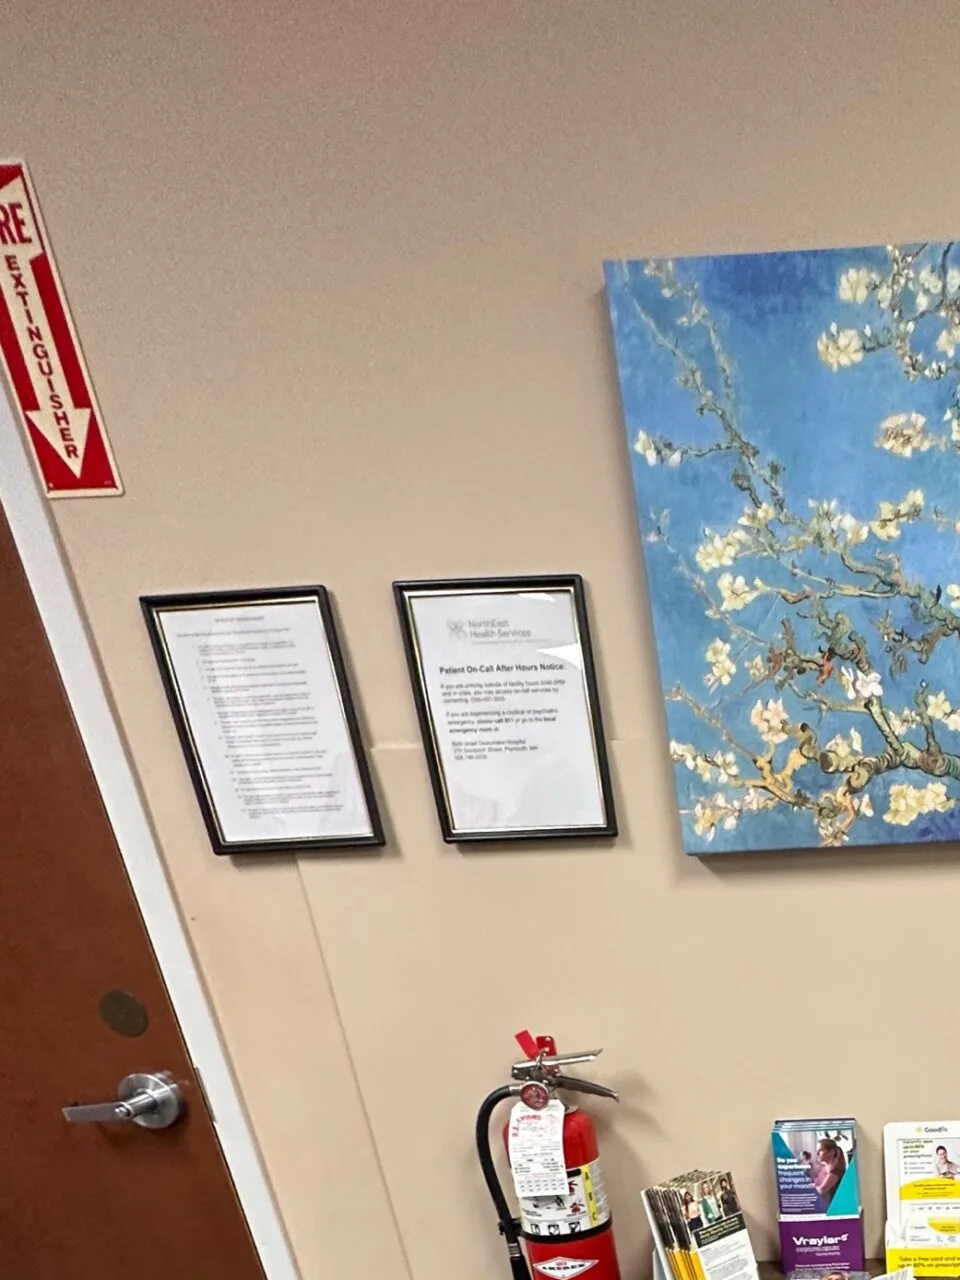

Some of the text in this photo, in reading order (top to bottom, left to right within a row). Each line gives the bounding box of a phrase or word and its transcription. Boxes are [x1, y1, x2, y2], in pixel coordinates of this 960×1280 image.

[0, 202, 33, 245] RE
[4, 254, 80, 460] EXTINGUISHER
[468, 619, 510, 629] NorthEast
[470, 628, 532, 639] Health Services
[439, 665, 465, 675] Patient
[466, 664, 494, 674] On-Call
[496, 663, 514, 673] After
[515, 663, 538, 672] Hours
[924, 1126, 949, 1134] GoodRx
[776, 1163, 811, 1171] experience
[777, 1169, 804, 1177] frequent
[779, 1176, 805, 1184] changes
[792, 1235, 842, 1247] Vraylar
[944, 1254, 956, 1262] and
